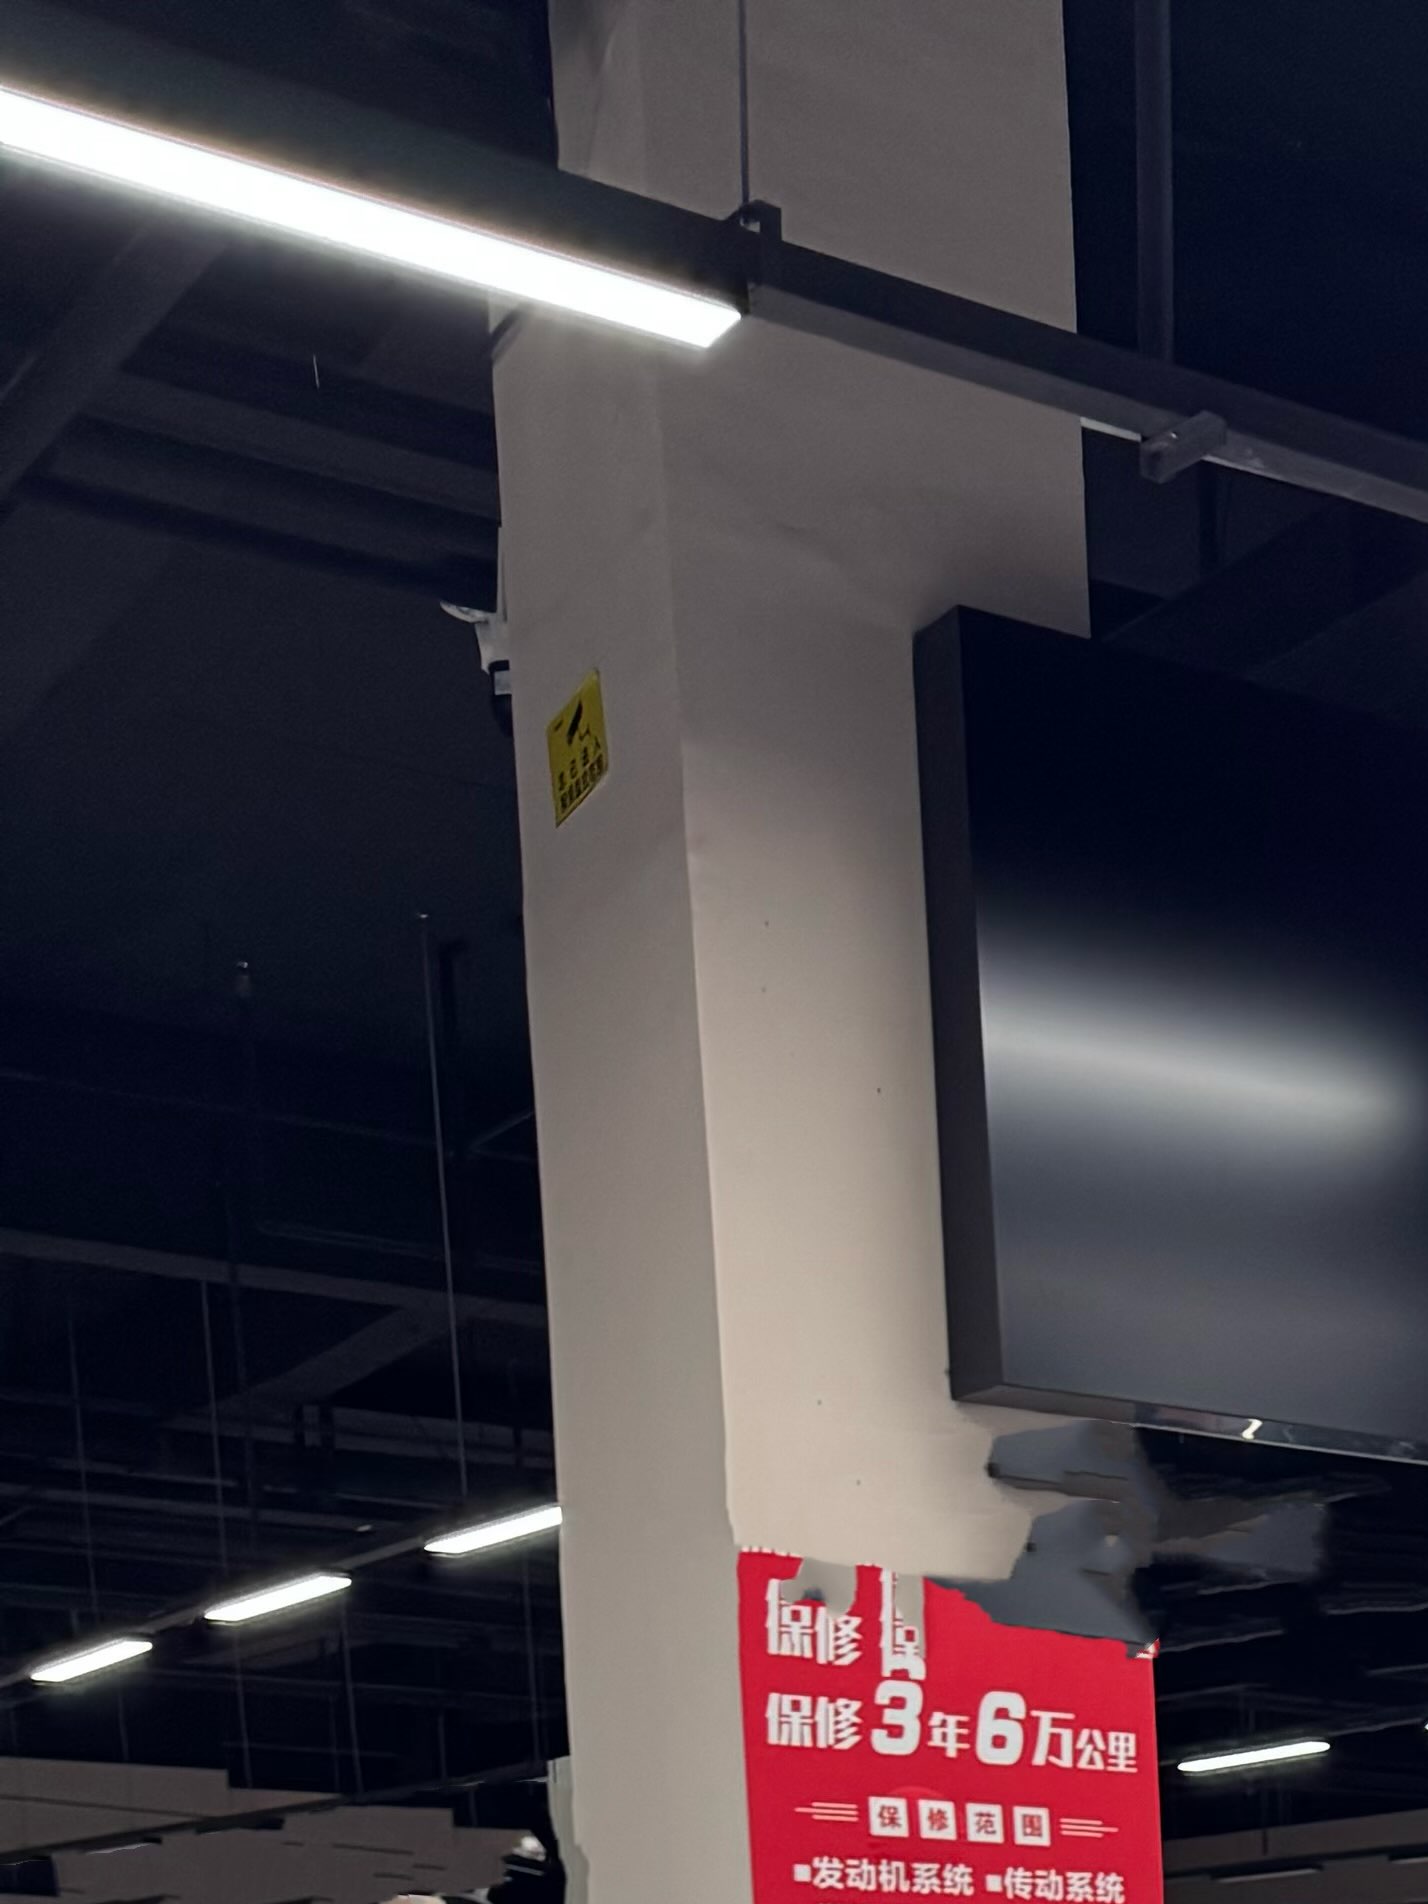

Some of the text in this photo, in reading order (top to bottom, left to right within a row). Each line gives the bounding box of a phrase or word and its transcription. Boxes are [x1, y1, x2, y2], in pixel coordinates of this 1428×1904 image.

[765, 1678, 1138, 1774] 保修3年6万公里
[875, 1801, 1046, 1841] 保修范围
[812, 1856, 975, 1896] 发动机系统
[1004, 1866, 1126, 1904] 传动系统
